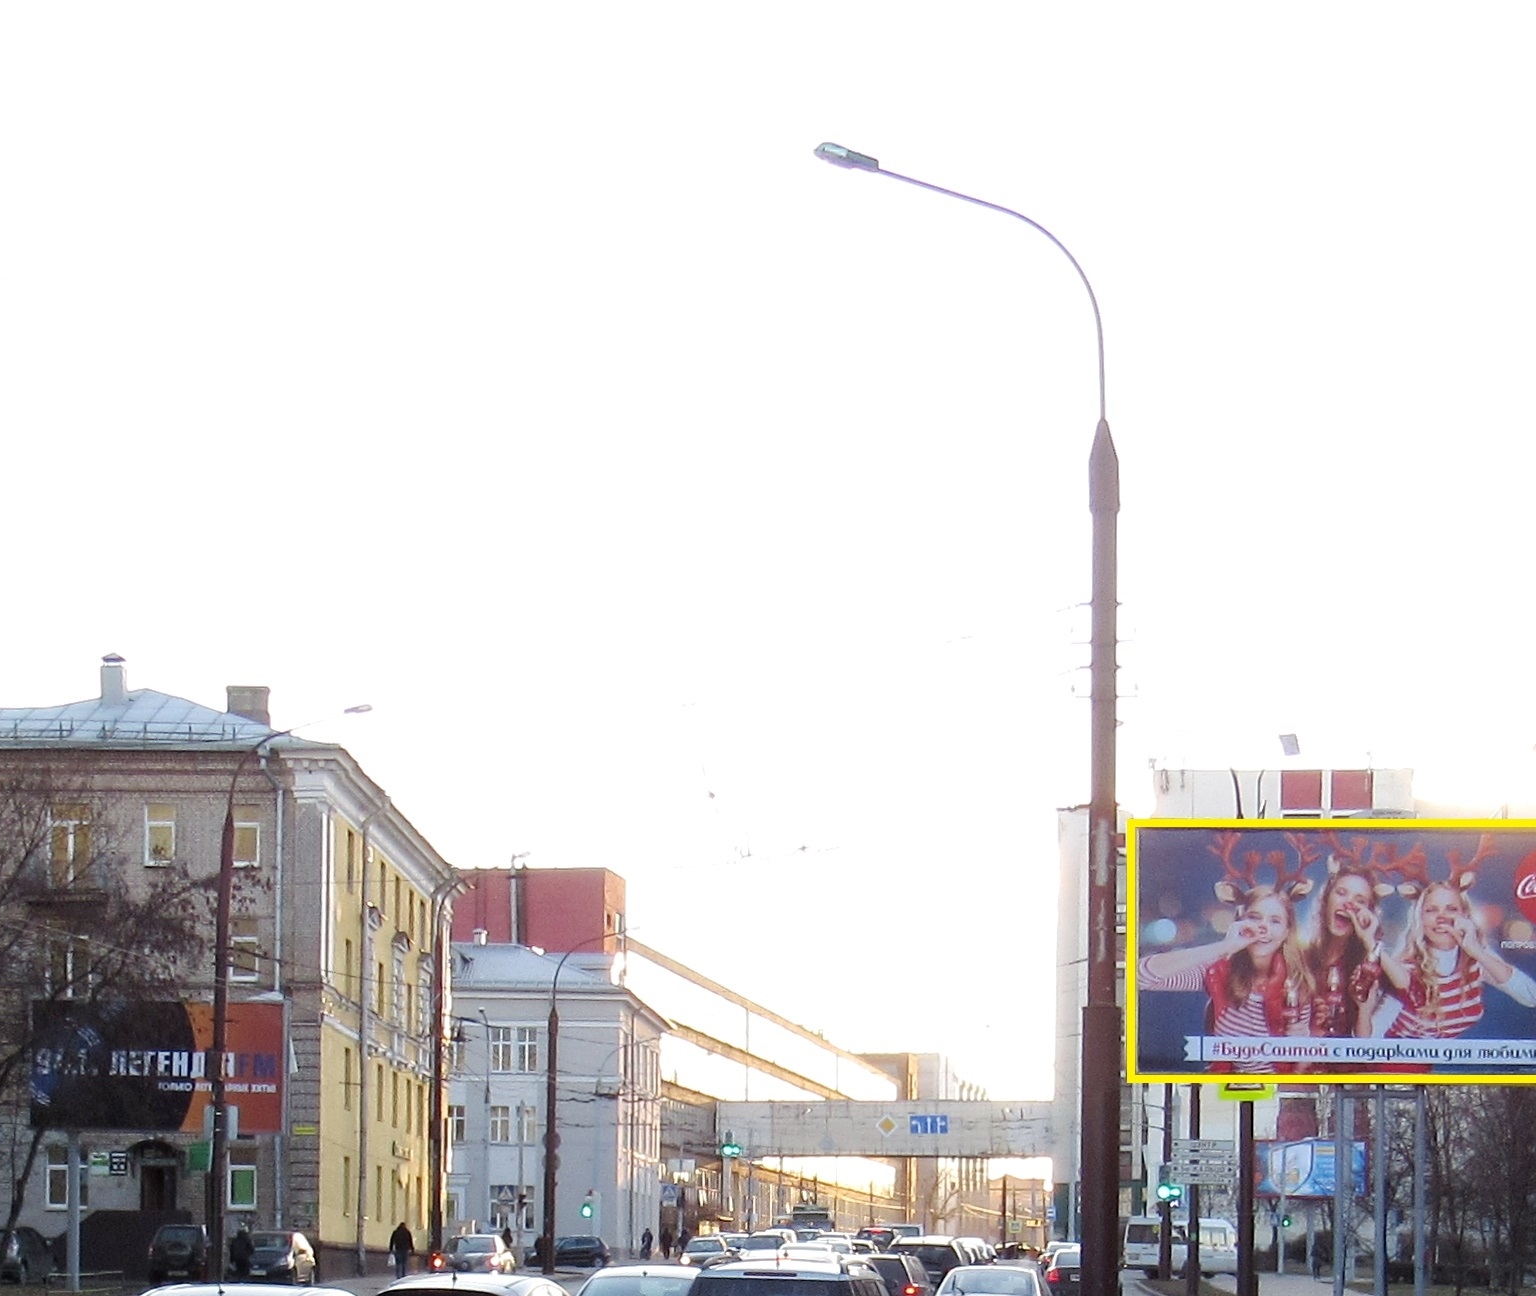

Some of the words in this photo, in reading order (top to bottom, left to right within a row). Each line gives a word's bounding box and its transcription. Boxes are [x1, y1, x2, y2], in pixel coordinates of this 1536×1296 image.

[1212, 1040, 1328, 1061] #БудьСантой
[1332, 1048, 1341, 1058] с
[1345, 1044, 1439, 1061] подарками
[1443, 1049, 1472, 1062] для
